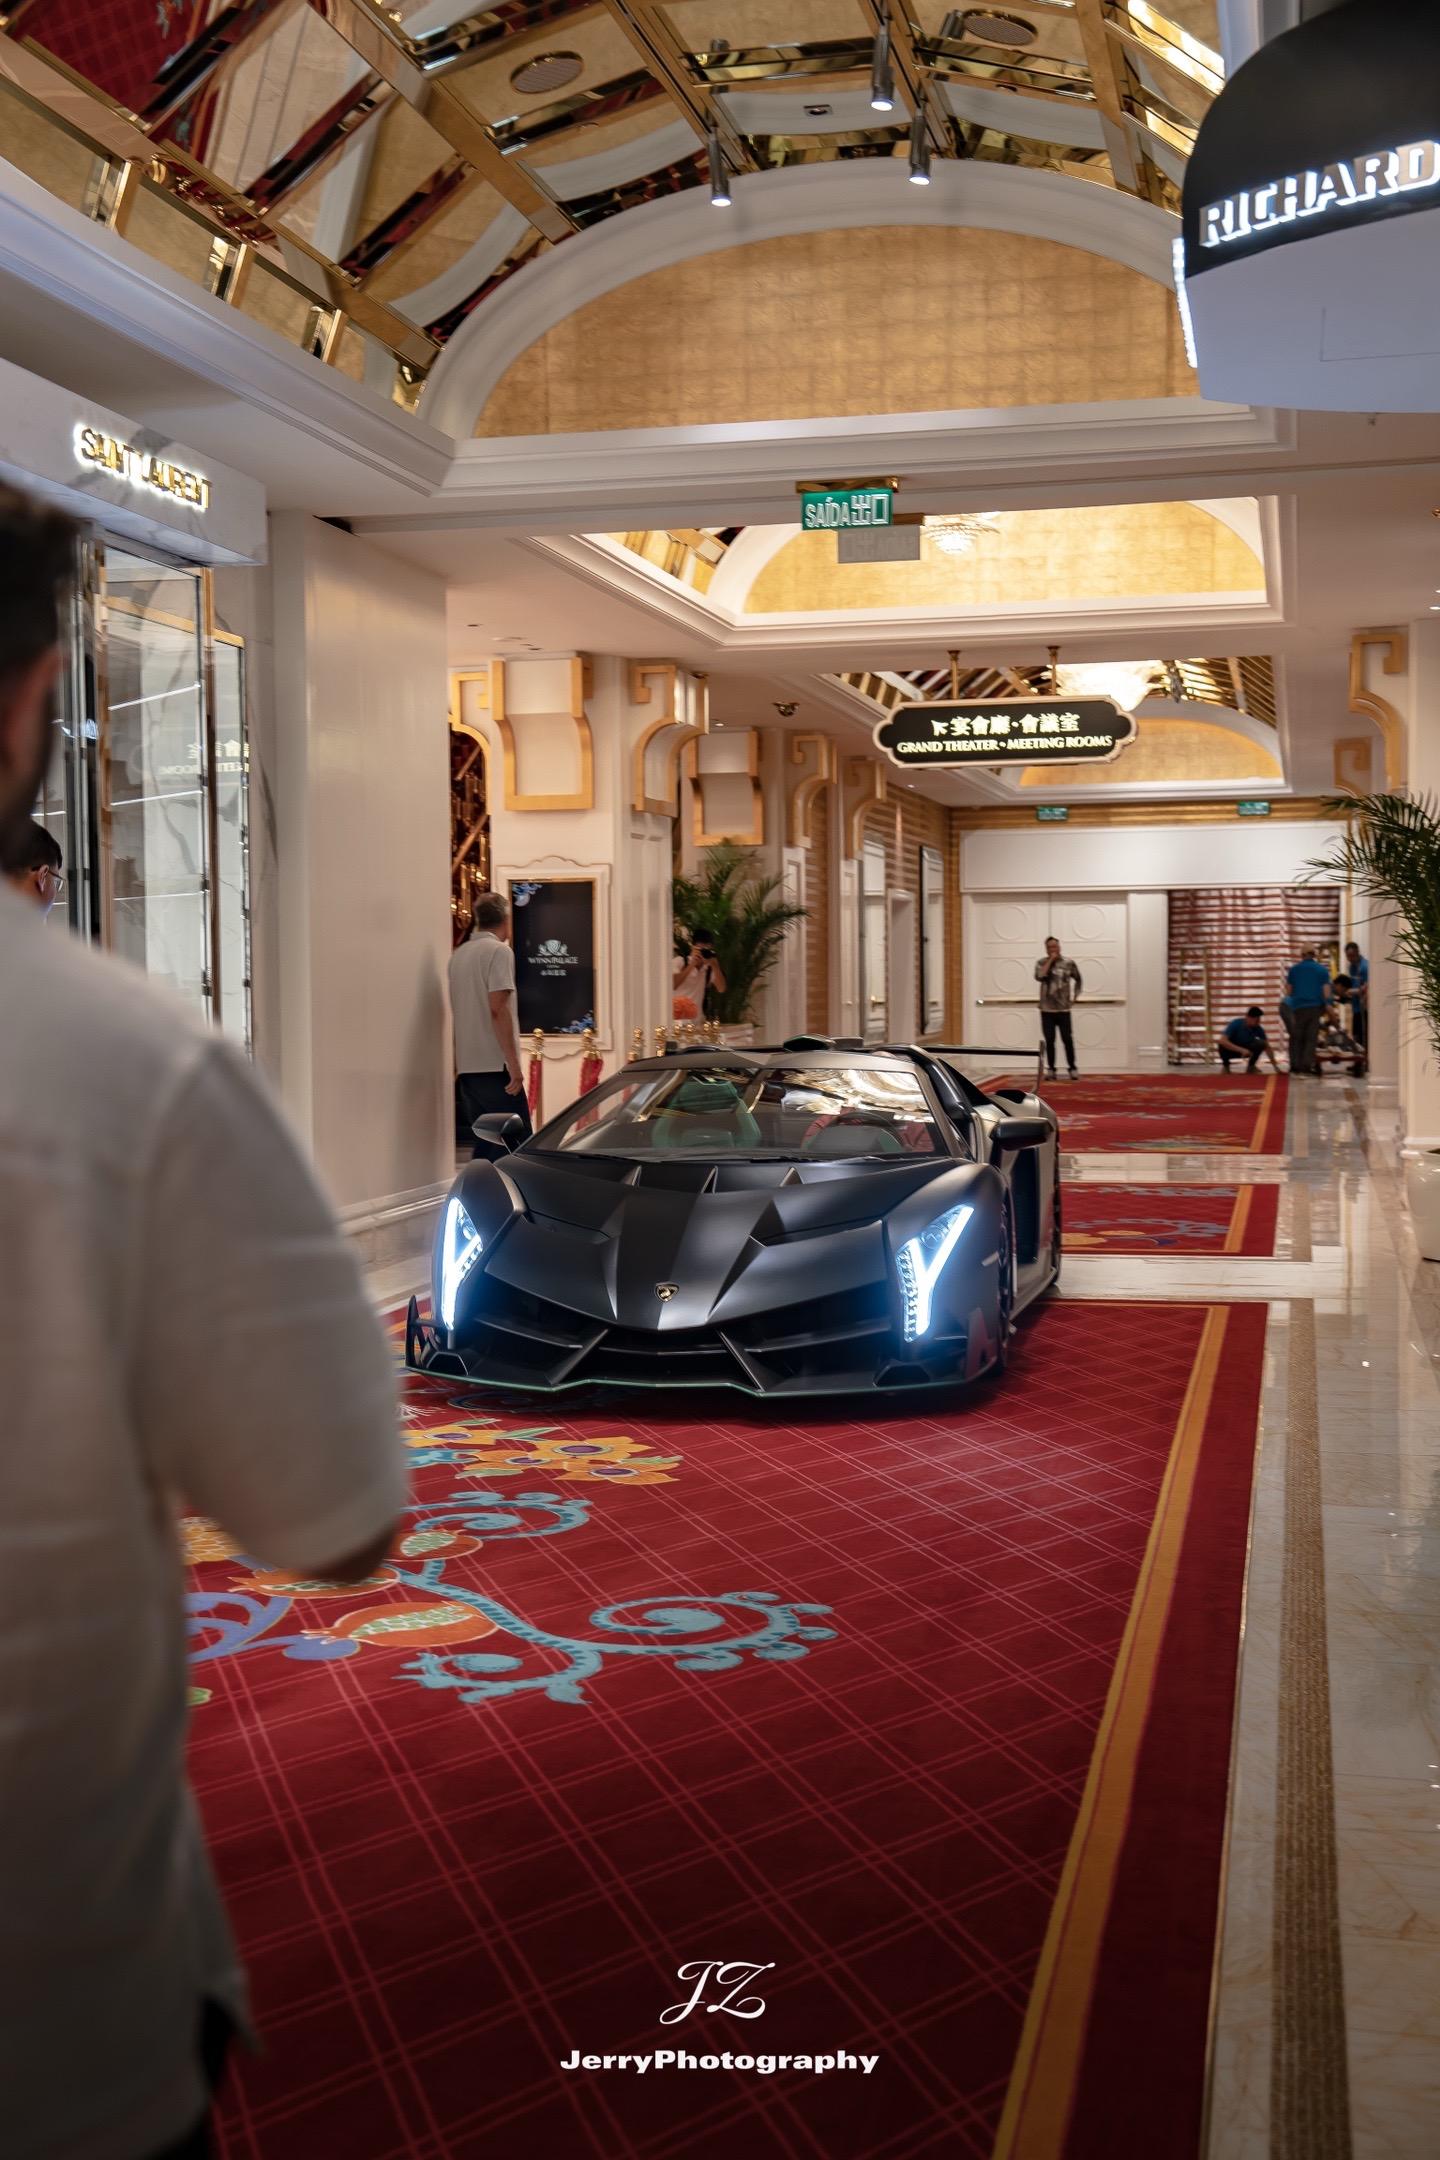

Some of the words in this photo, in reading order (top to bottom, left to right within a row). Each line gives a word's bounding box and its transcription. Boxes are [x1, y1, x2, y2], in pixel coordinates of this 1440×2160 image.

[1199, 139, 1440, 248] RICHARD
[805, 496, 851, 528] SAÍDA
[850, 493, 890, 525] 出口
[896, 741, 944, 753] GRAND
[942, 739, 1000, 752] THEATER
[1006, 737, 1065, 750] MEETING
[1064, 735, 1113, 748] ROOMS
